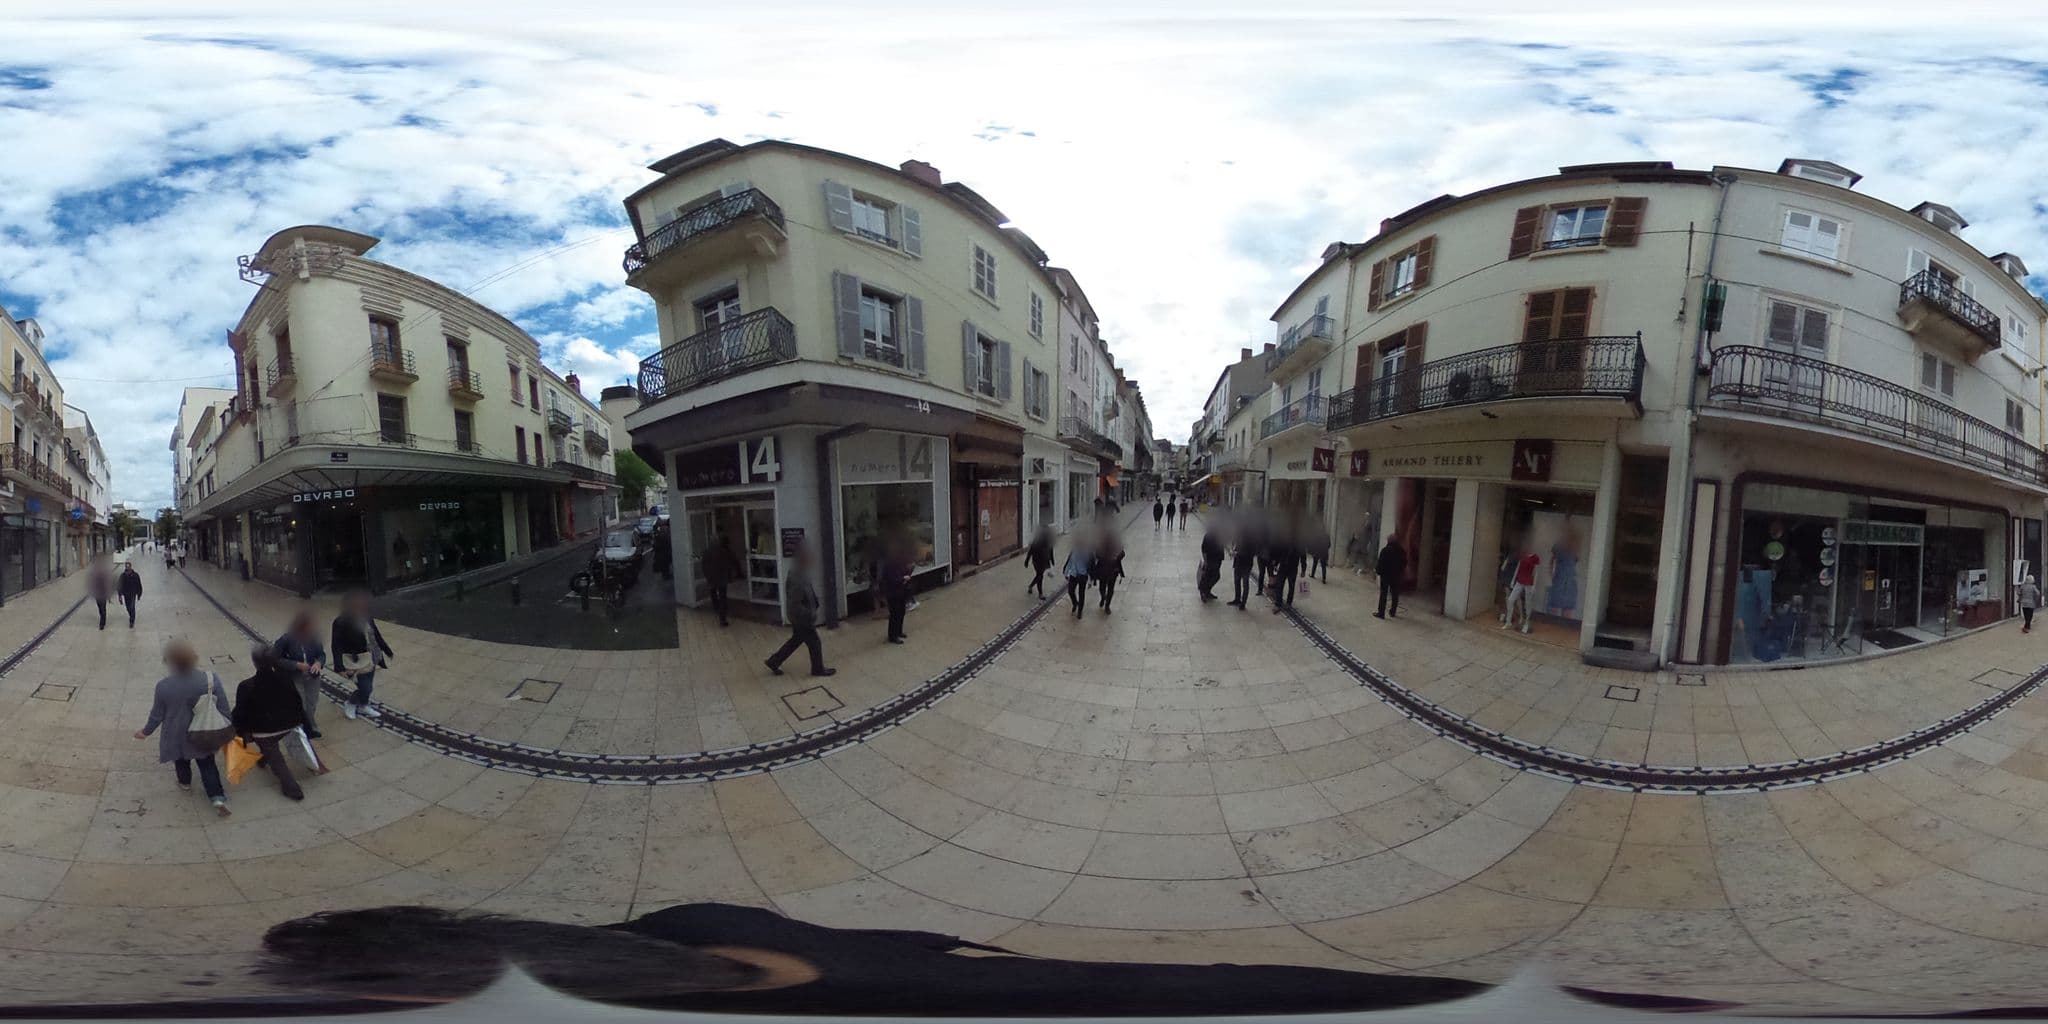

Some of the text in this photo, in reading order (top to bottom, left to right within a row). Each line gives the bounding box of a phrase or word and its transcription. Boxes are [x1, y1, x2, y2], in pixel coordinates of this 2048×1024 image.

[738, 436, 780, 484] 14
[899, 435, 932, 480] 14
[1383, 455, 1483, 467] ARMAND THIERY
